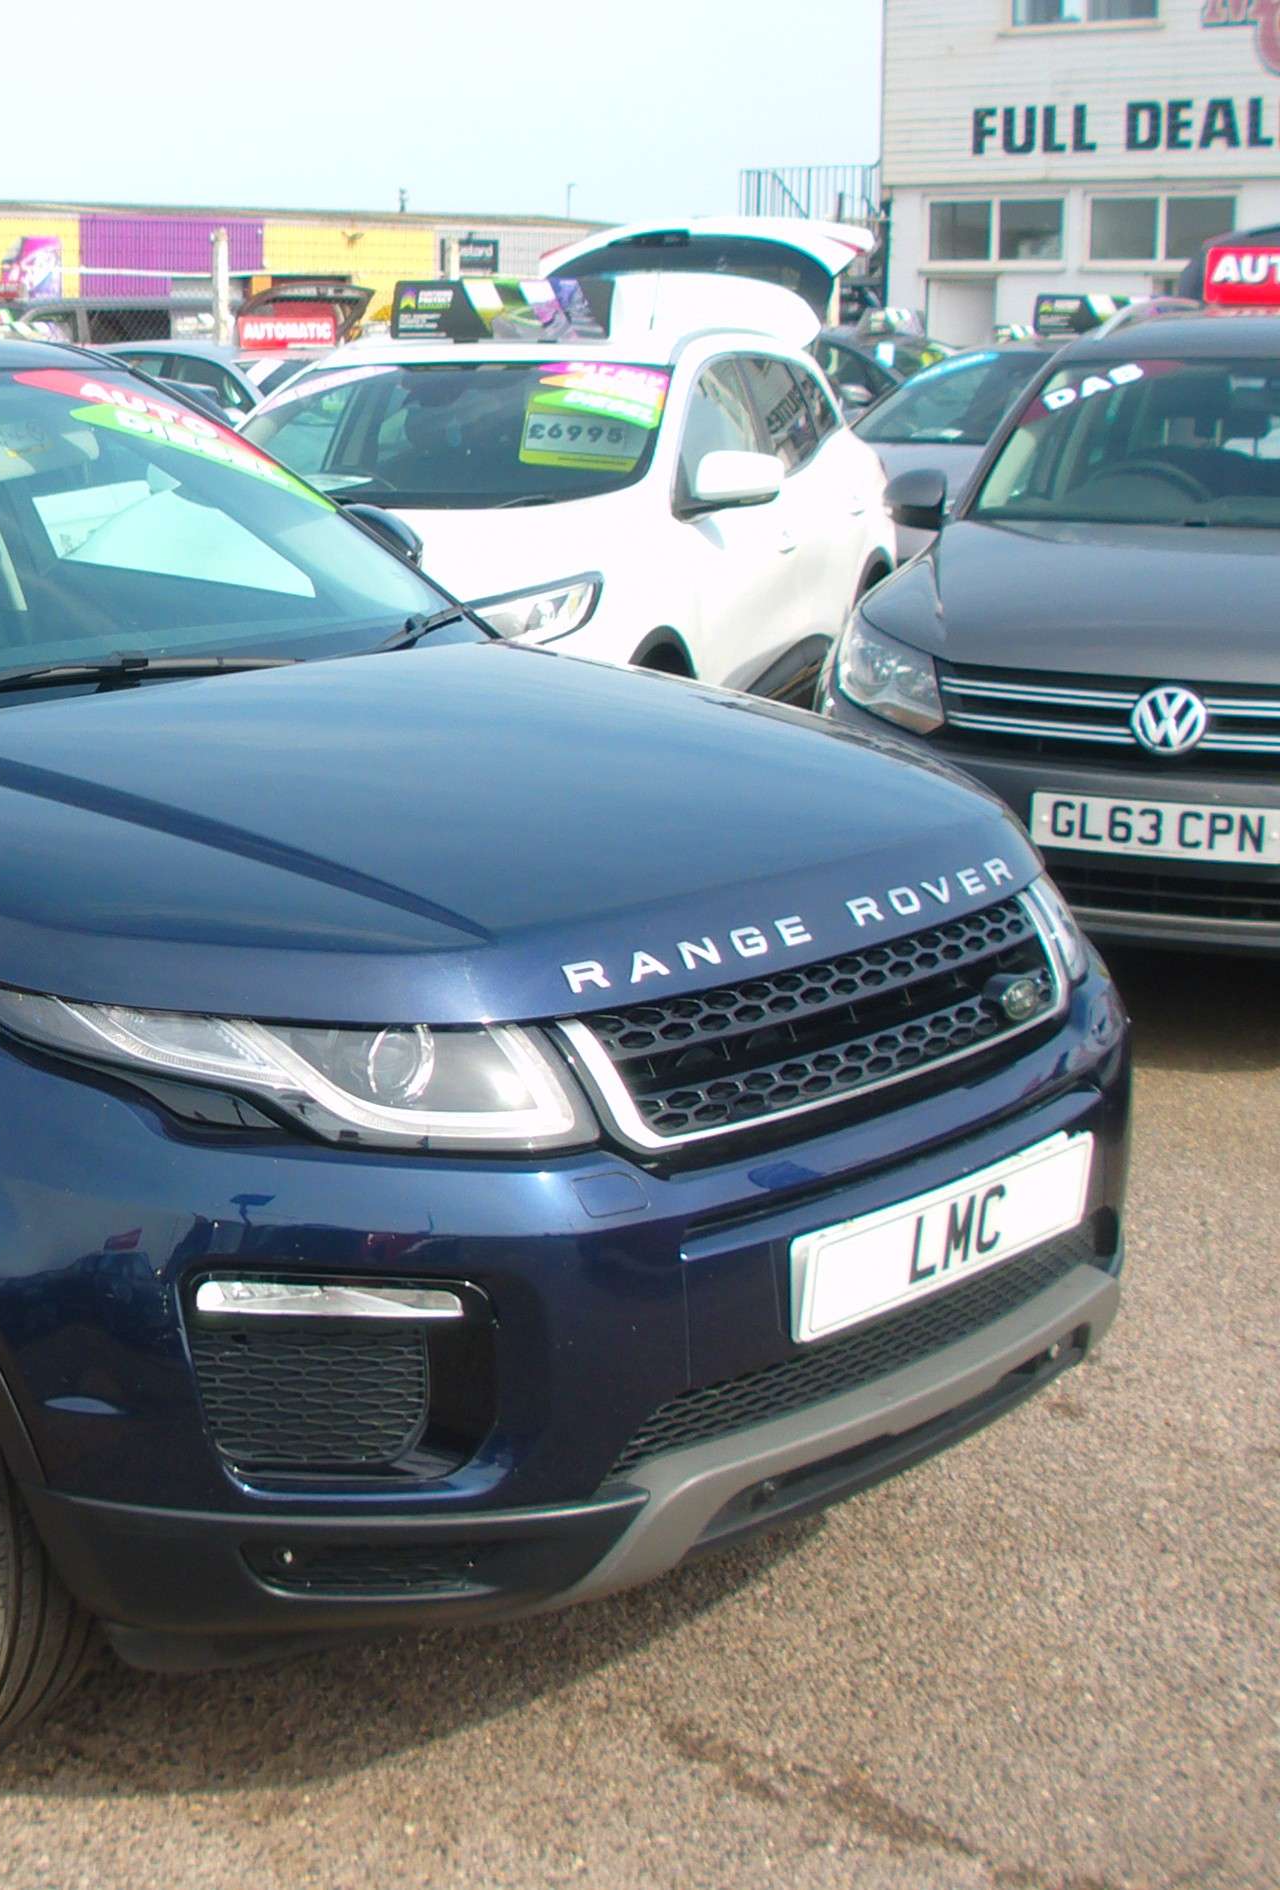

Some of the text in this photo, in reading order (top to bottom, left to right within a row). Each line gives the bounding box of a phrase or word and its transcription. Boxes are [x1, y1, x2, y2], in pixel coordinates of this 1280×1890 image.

[972, 104, 1097, 155] FULL
[243, 321, 333, 341] AUTOMATIC
[79, 382, 219, 440] AUTO
[1043, 363, 1145, 411] DAB
[528, 423, 626, 444] £6995
[1051, 801, 1266, 854] GL63 CPN
[561, 857, 1014, 995] RANGE ROVER
[909, 1184, 1008, 1284] LMC
